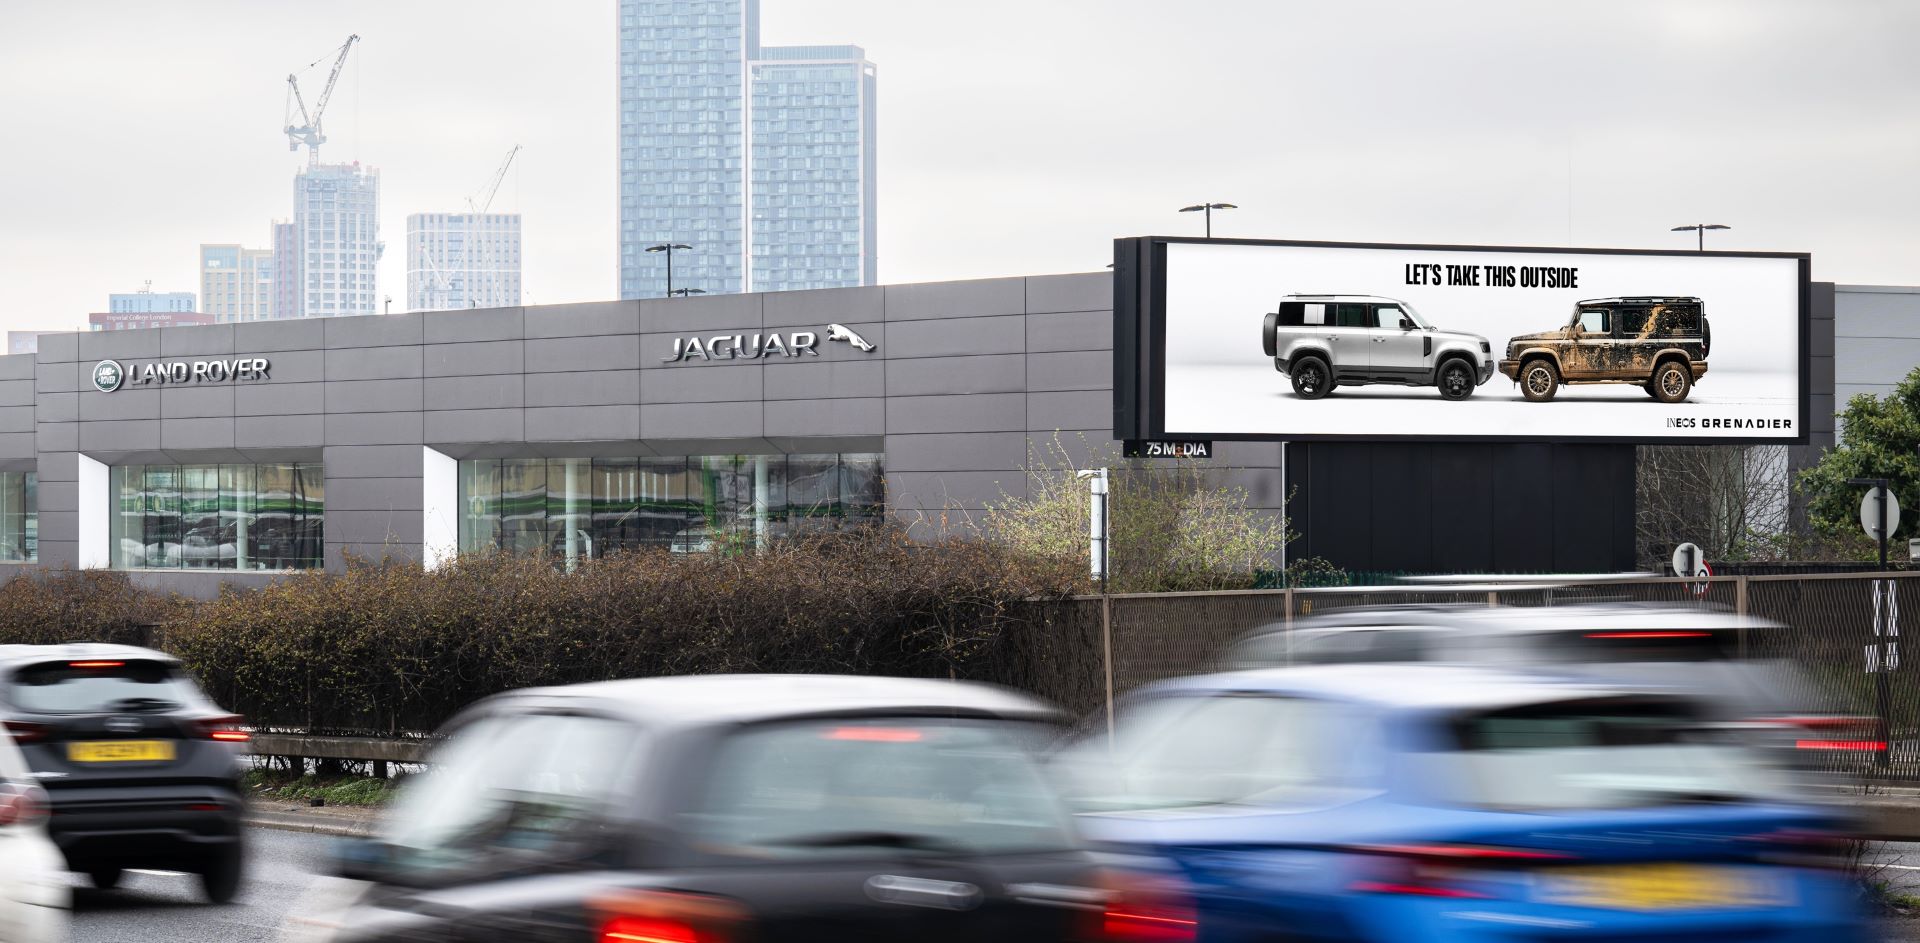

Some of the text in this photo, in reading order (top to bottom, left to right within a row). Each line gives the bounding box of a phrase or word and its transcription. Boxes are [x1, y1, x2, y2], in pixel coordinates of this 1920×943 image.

[1405, 263, 1578, 289] LET'S TAKE THIS OUTSIDE
[149, 313, 172, 321] London
[661, 331, 819, 363] JAGUAR
[129, 358, 271, 386] LAND ROVER
[1666, 417, 1792, 429] INEOS GRENADIER
